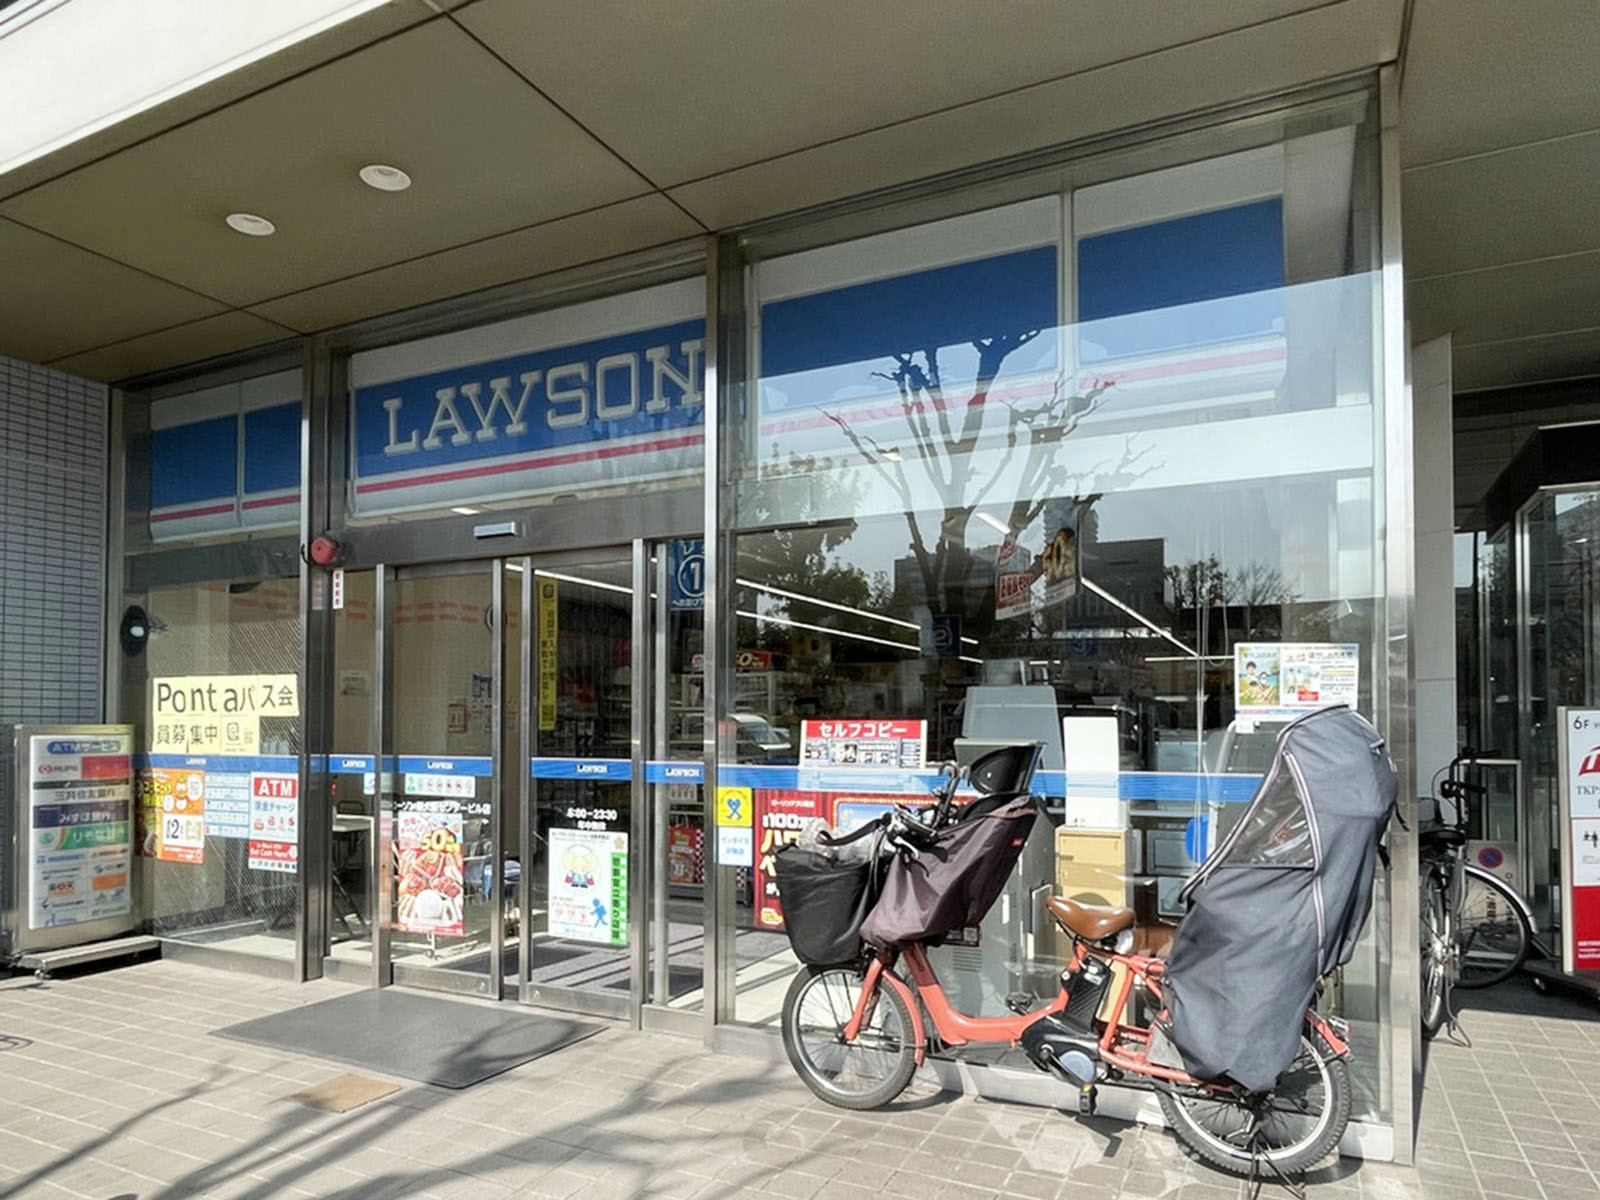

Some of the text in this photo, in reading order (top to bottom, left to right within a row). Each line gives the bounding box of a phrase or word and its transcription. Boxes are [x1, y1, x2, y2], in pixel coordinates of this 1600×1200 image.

[383, 338, 705, 455] LAWSON
[819, 722, 908, 738] セルフコピー
[1573, 716, 1589, 730] 6F
[156, 724, 218, 745] 員募集中
[258, 780, 292, 796] ATM
